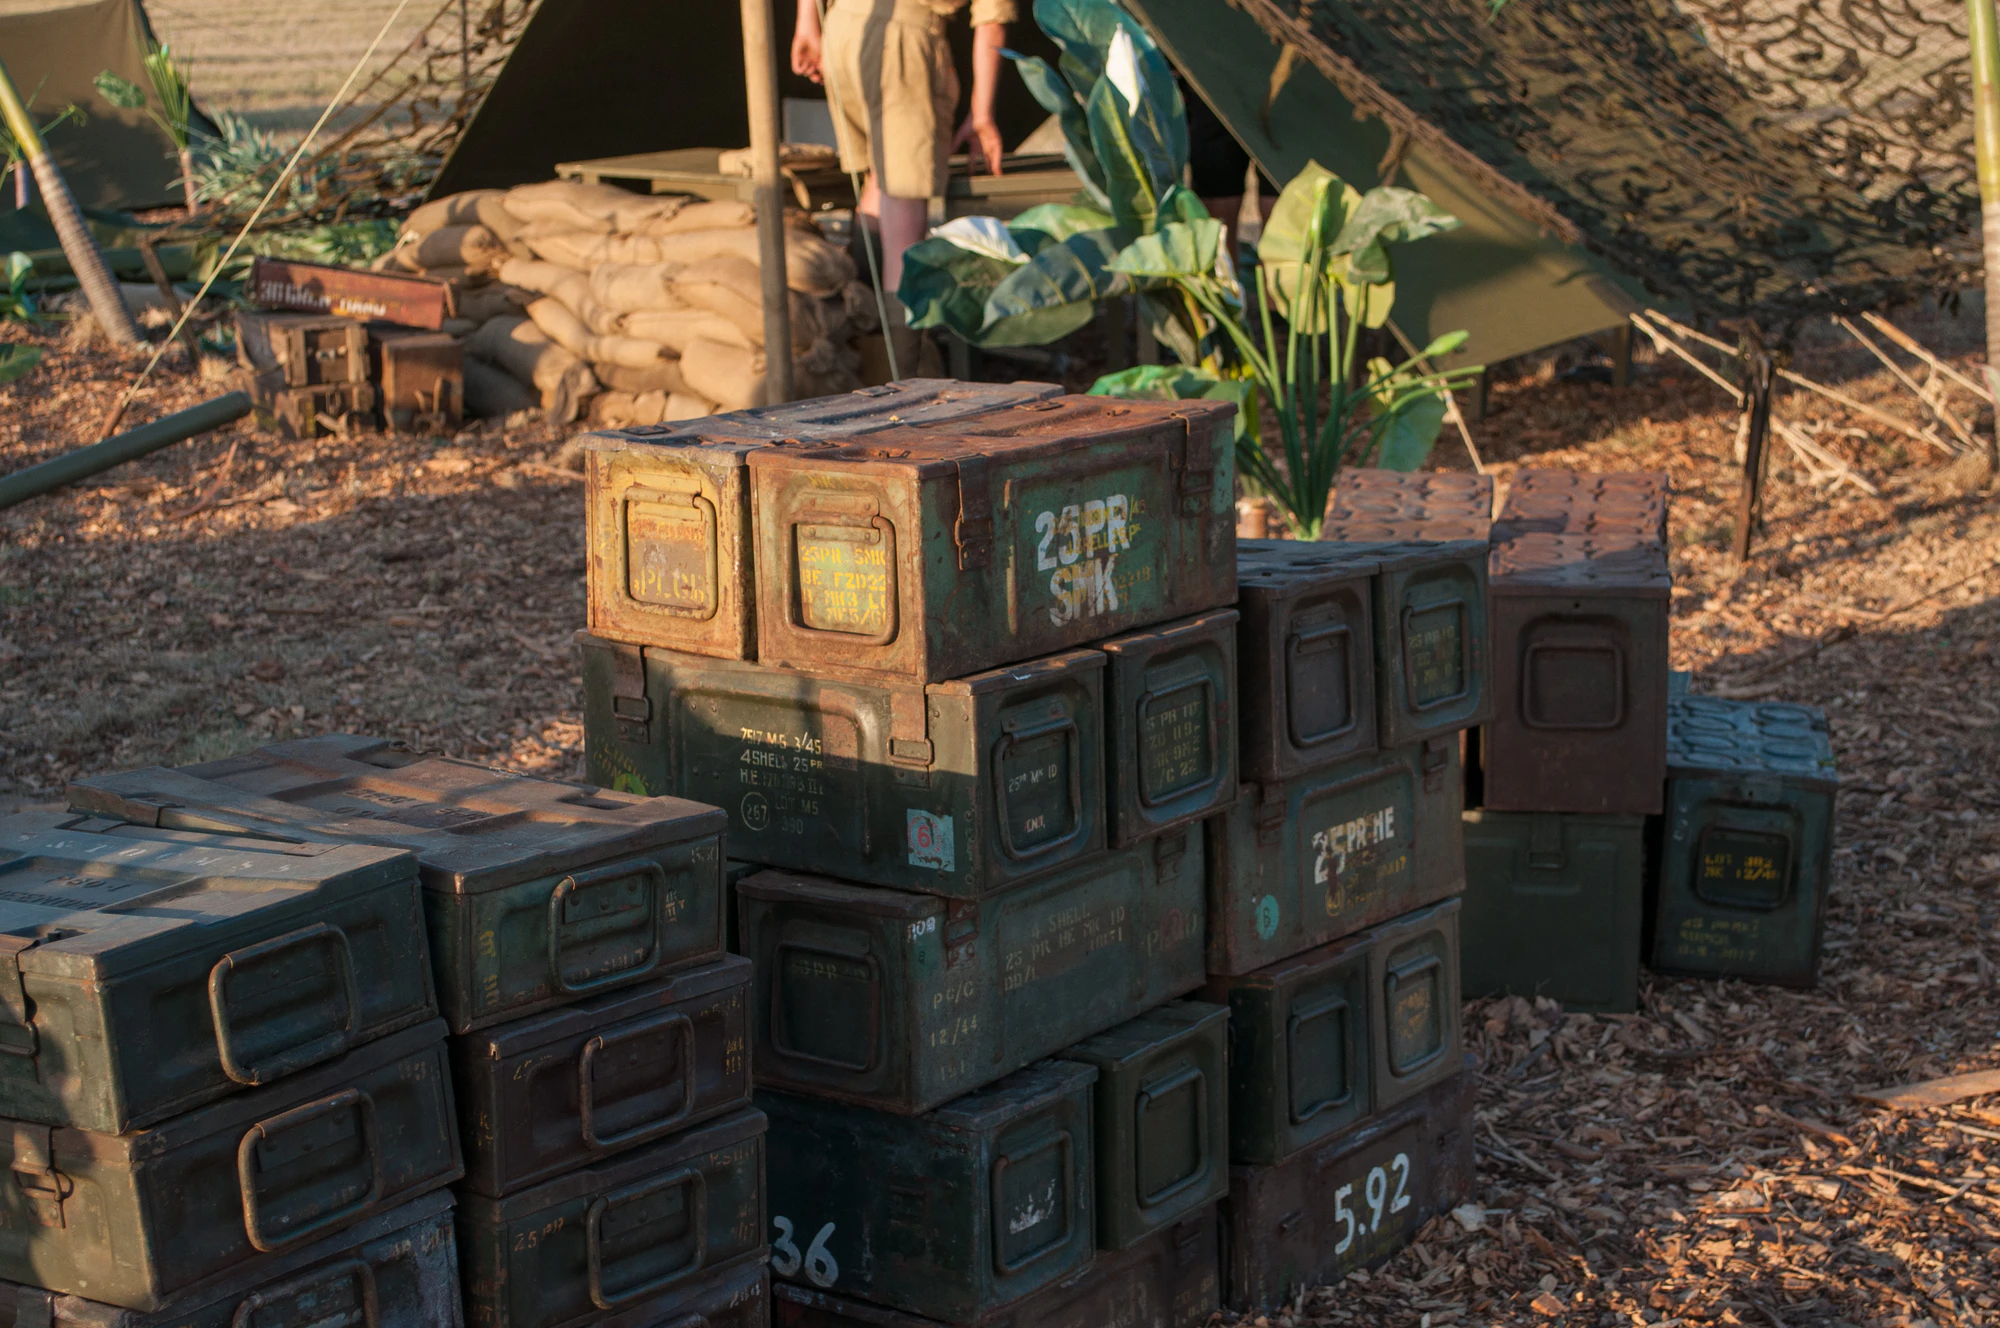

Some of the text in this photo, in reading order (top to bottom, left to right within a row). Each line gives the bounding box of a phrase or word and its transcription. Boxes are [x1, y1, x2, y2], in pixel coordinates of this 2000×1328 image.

[1050, 553, 1120, 628] SMK
[794, 732, 822, 755] 3/45
[746, 804, 767, 822] 267
[917, 825, 931, 848] 6
[1334, 1152, 1412, 1256] 5.92
[771, 1216, 839, 1288] 36
